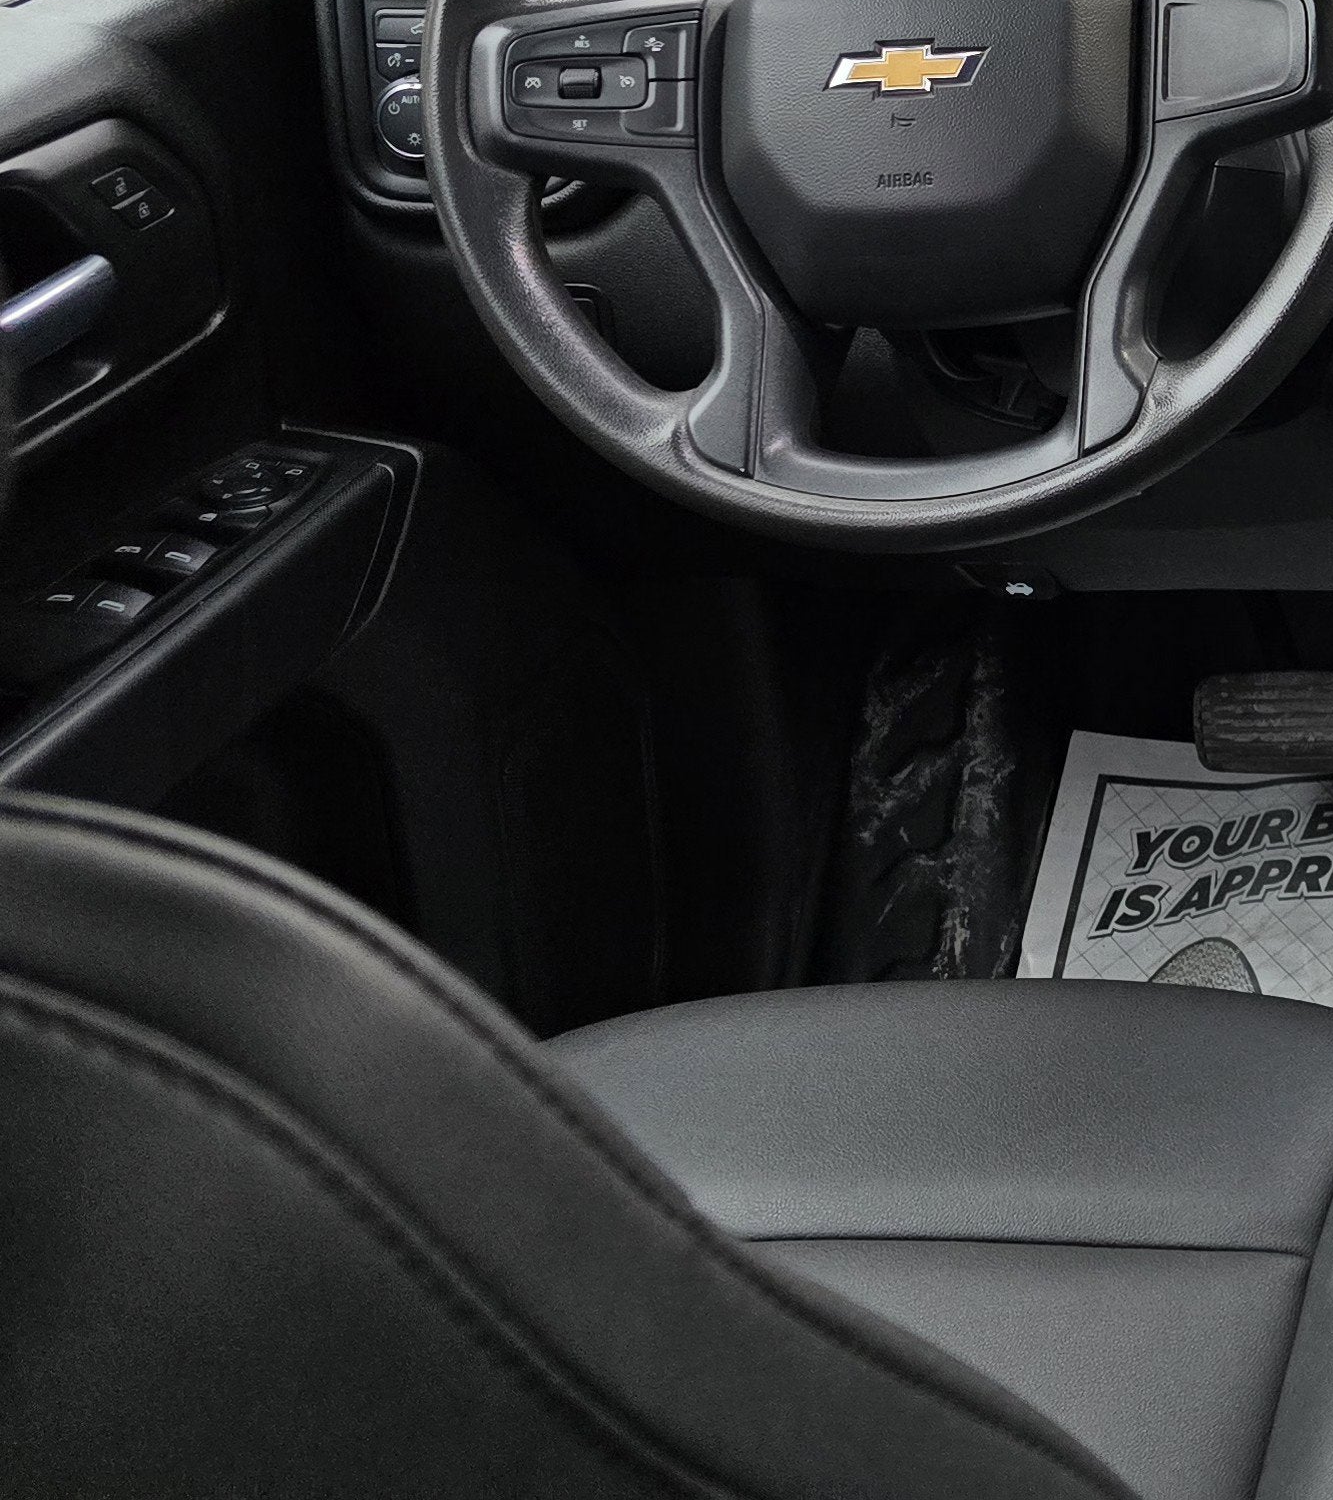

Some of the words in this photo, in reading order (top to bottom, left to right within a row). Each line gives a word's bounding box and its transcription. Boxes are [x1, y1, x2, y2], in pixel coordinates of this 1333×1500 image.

[401, 95, 420, 105] AUT
[877, 172, 935, 188] AIRBAG
[1129, 808, 1295, 872] YOUR
[1092, 882, 1166, 937] IS
